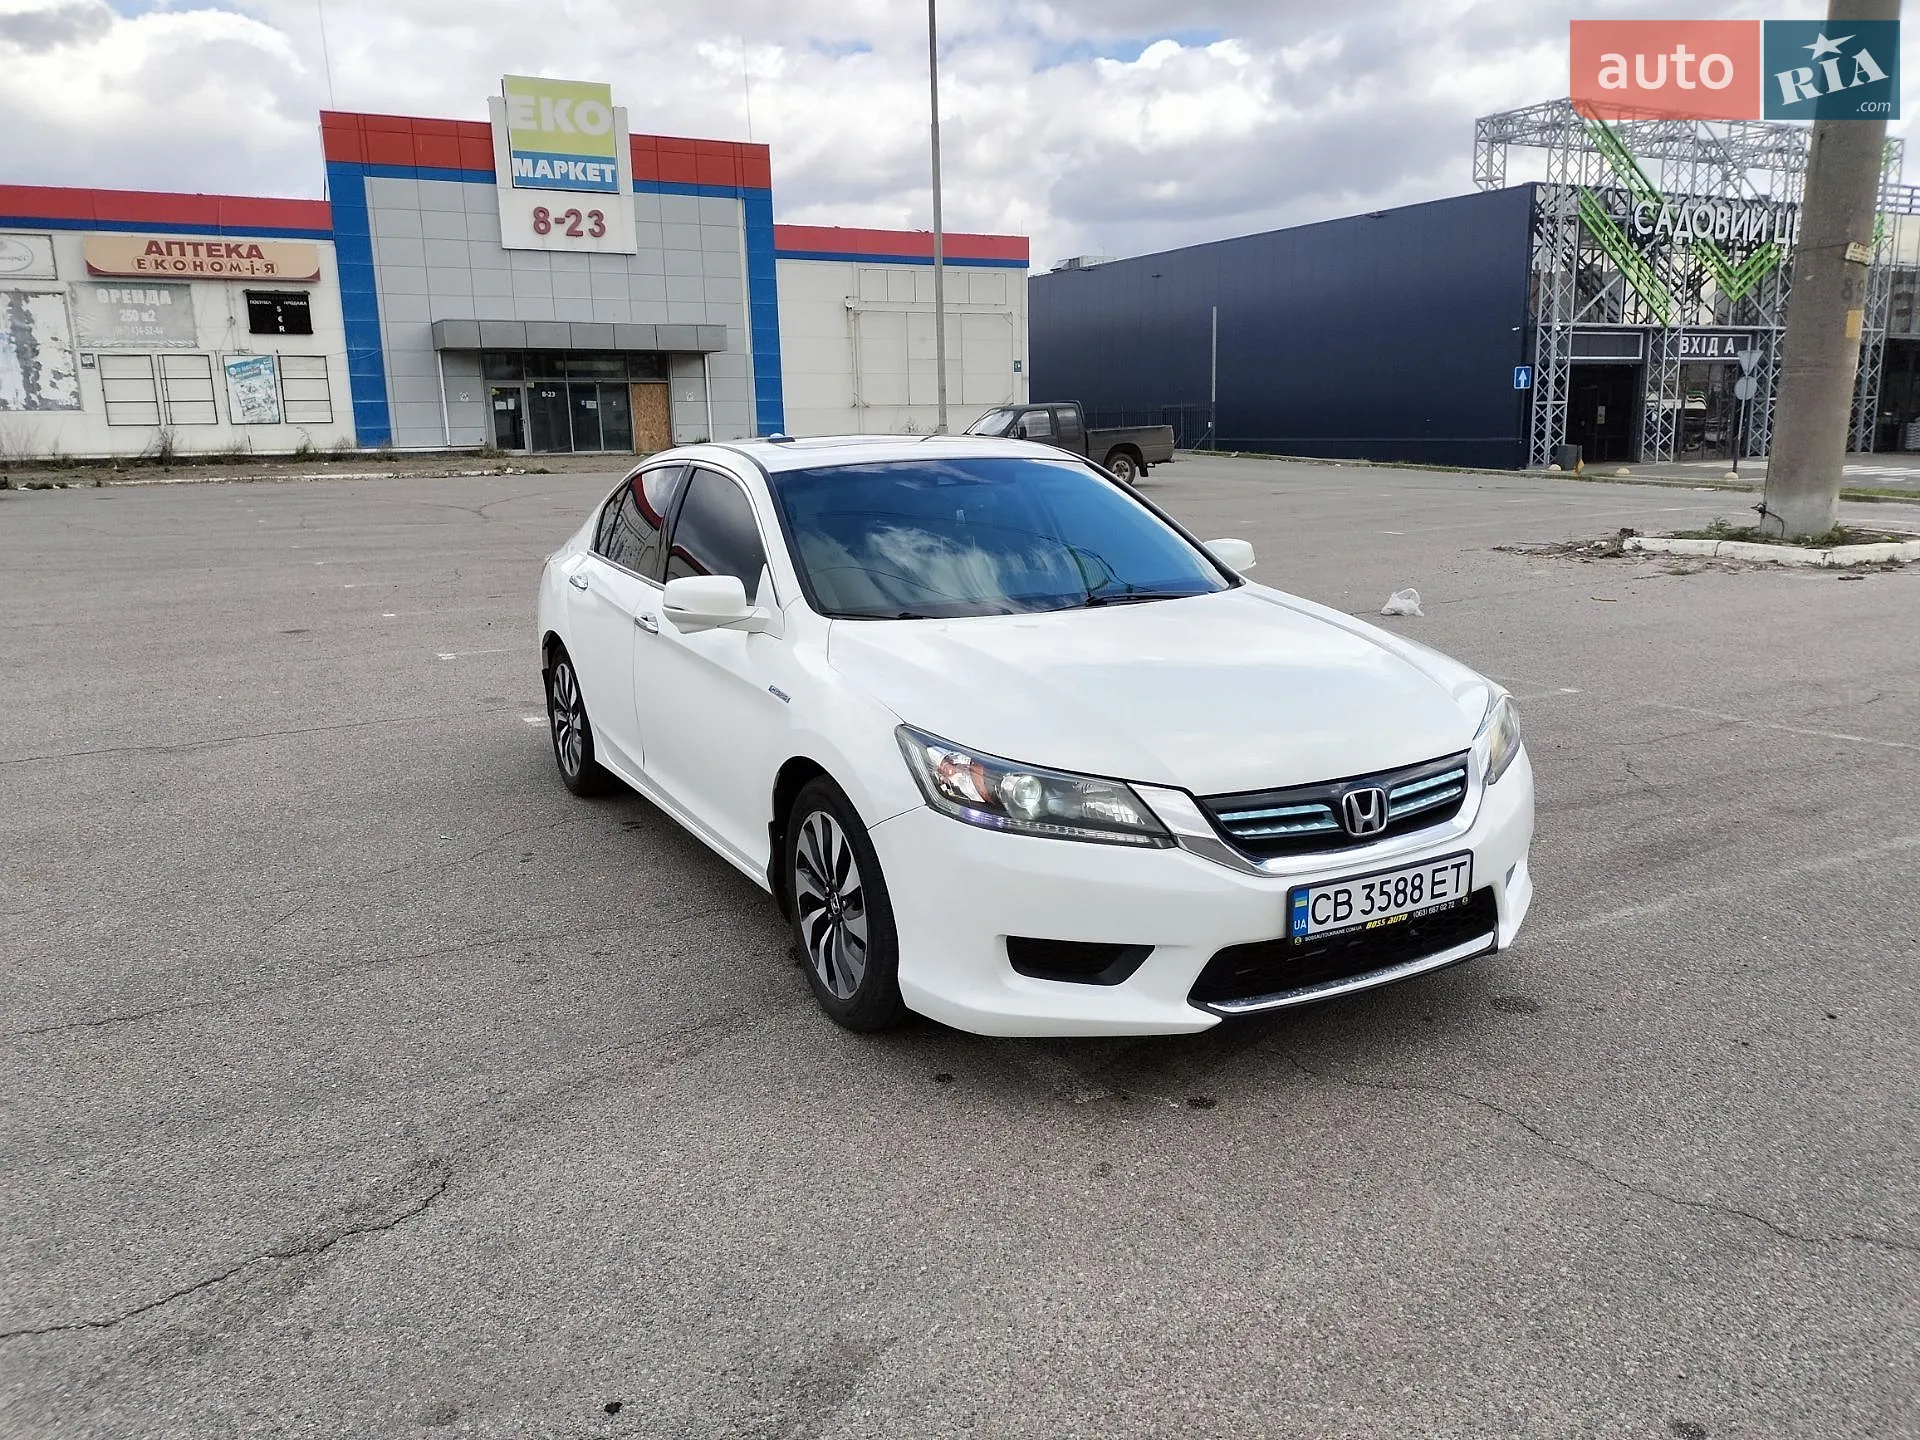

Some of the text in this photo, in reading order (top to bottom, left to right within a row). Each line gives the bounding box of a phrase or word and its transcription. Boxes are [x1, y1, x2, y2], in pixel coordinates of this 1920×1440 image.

[508, 94, 613, 136] ЕКО
[512, 157, 616, 183] МАРКЕТ
[533, 206, 606, 238] 8-23
[144, 240, 265, 260] АПТЕКА
[1682, 337, 1719, 356] ВХІД
[1311, 861, 1468, 926] CB 3588 ET
[1294, 920, 1307, 931] UA
[1366, 919, 1386, 930] BOSS
